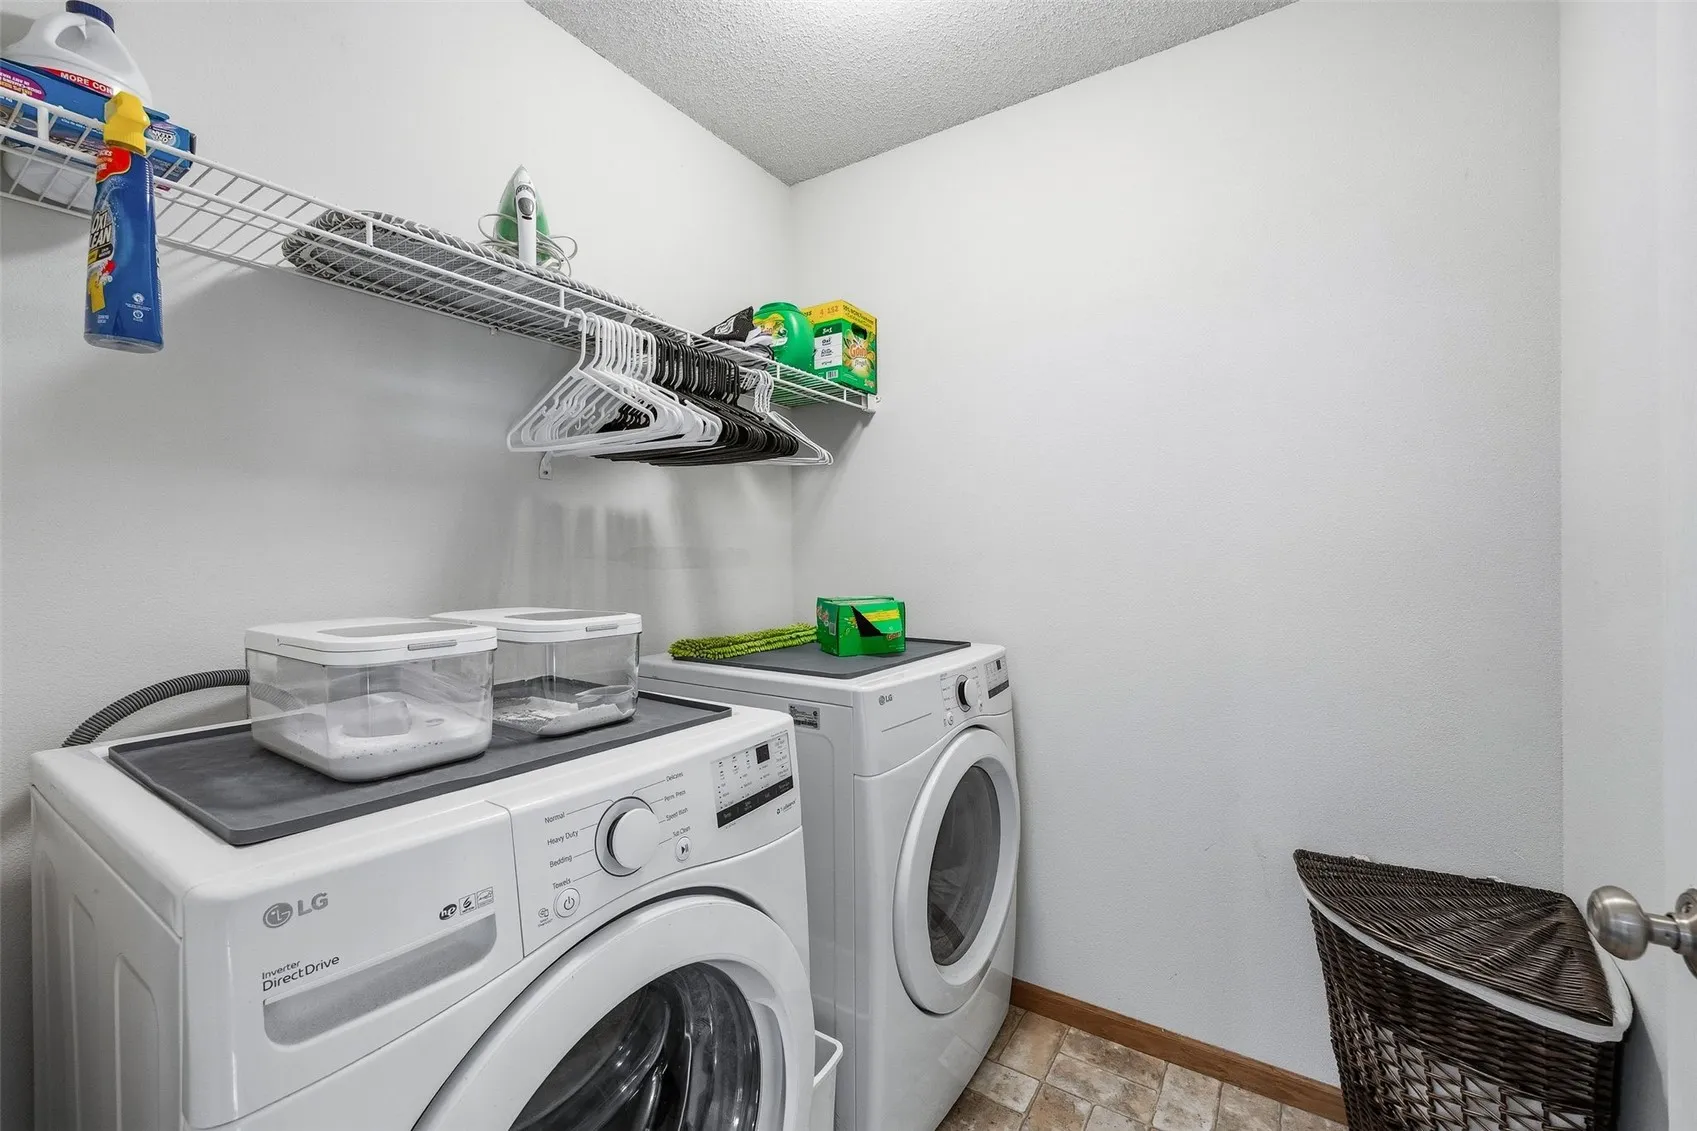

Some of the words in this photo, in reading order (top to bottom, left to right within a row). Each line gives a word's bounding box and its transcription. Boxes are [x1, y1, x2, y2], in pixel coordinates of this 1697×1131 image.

[60, 71, 91, 87] MORE
[91, 210, 109, 232] OXI
[544, 812, 566, 824] Normal
[547, 836, 565, 845] Heavy
[565, 830, 578, 839] Duty
[549, 855, 573, 868] Bedding
[552, 877, 571, 890] Towels
[297, 892, 329, 917] LG
[262, 960, 301, 979] Inverter
